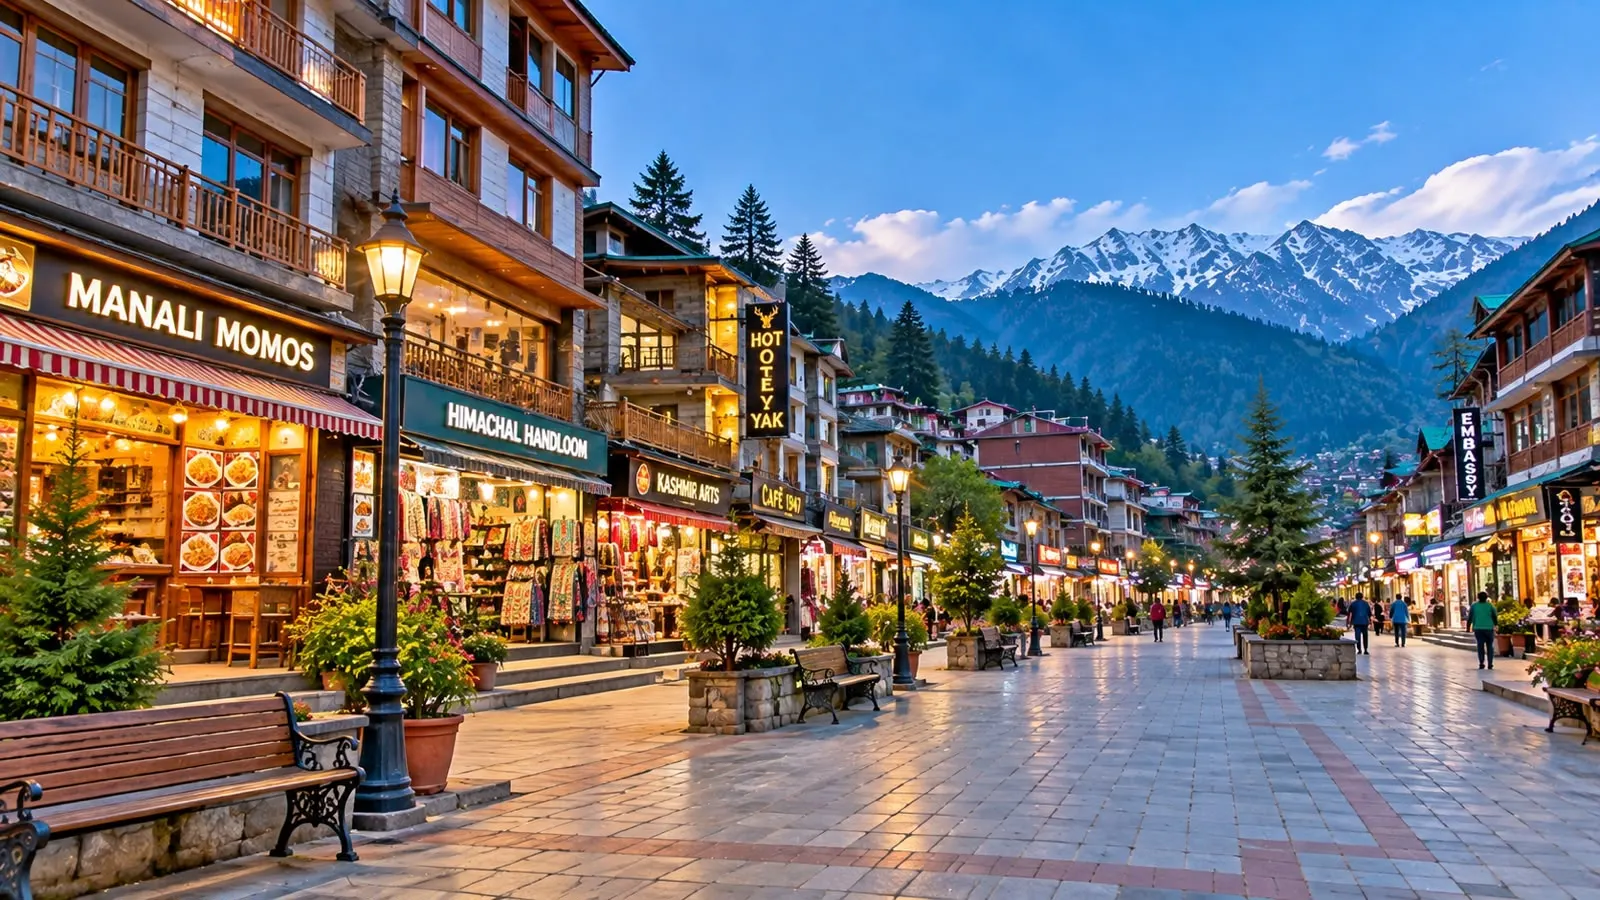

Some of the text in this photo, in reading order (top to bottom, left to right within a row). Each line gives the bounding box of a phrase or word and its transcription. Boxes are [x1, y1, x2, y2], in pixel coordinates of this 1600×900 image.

[67, 272, 315, 372] MANALI MOMOS
[750, 330, 784, 349] HOT
[447, 402, 588, 460] HIMACHAL HANDLOOM
[750, 411, 784, 429] YAK
[657, 472, 698, 500] KASHMIR
[698, 483, 720, 505] ARTS
